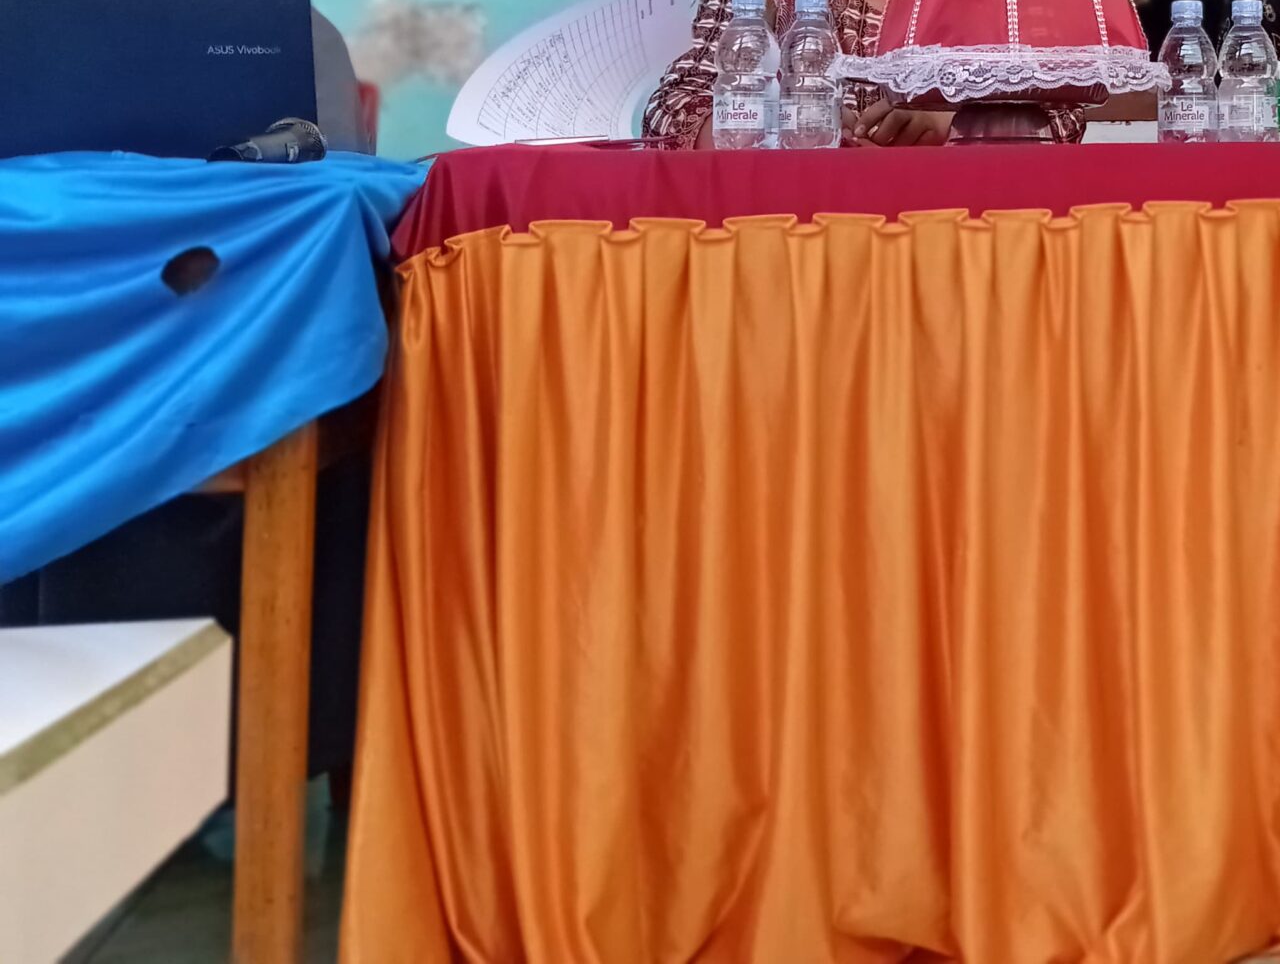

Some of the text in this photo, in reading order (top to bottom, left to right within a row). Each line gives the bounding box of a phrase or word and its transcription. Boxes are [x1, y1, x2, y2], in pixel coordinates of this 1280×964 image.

[207, 45, 234, 54] ASUS
[732, 100, 745, 110] Le
[1181, 101, 1193, 111] Le
[717, 109, 758, 120] Minerale
[1164, 110, 1205, 121] Minerale
